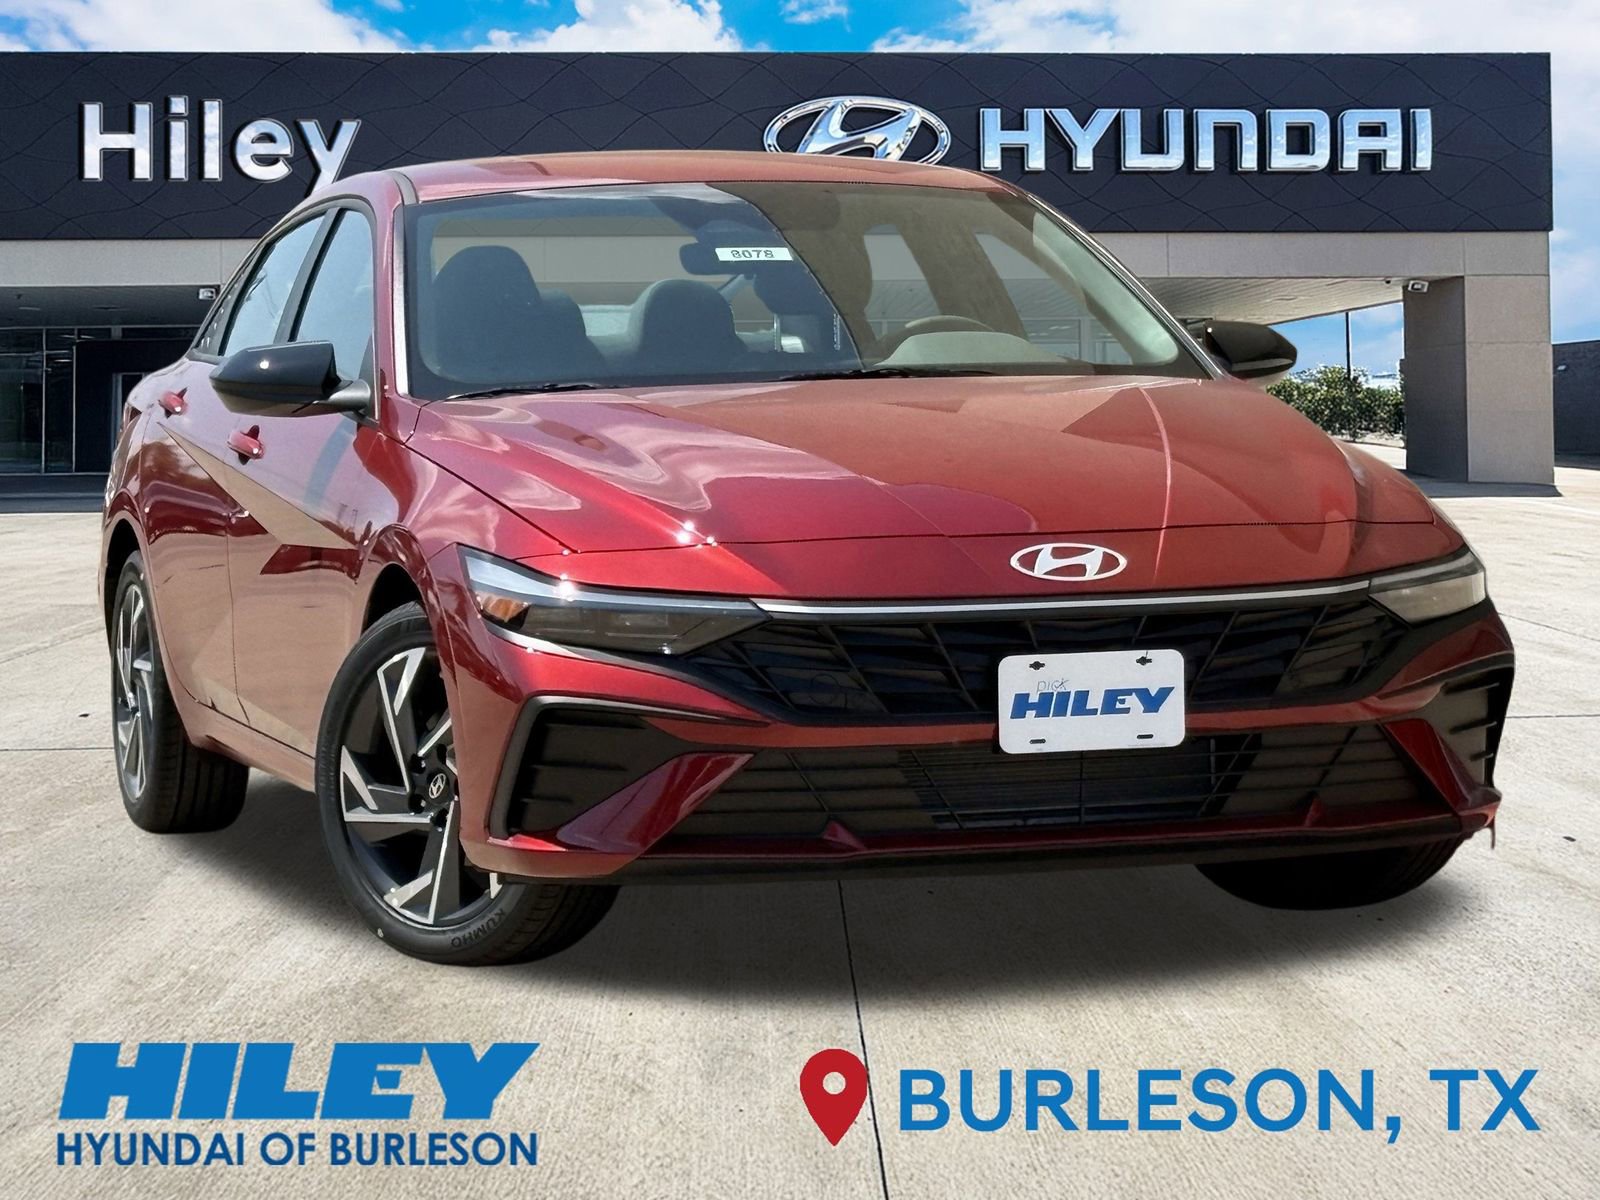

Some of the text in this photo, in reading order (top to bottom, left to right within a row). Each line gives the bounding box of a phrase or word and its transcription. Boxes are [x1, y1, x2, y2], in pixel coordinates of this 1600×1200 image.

[80, 95, 361, 198] Hiley
[979, 107, 1432, 172] HYUNDAI
[1010, 686, 1175, 719] HILEY
[450, 908, 506, 949] KUMHO
